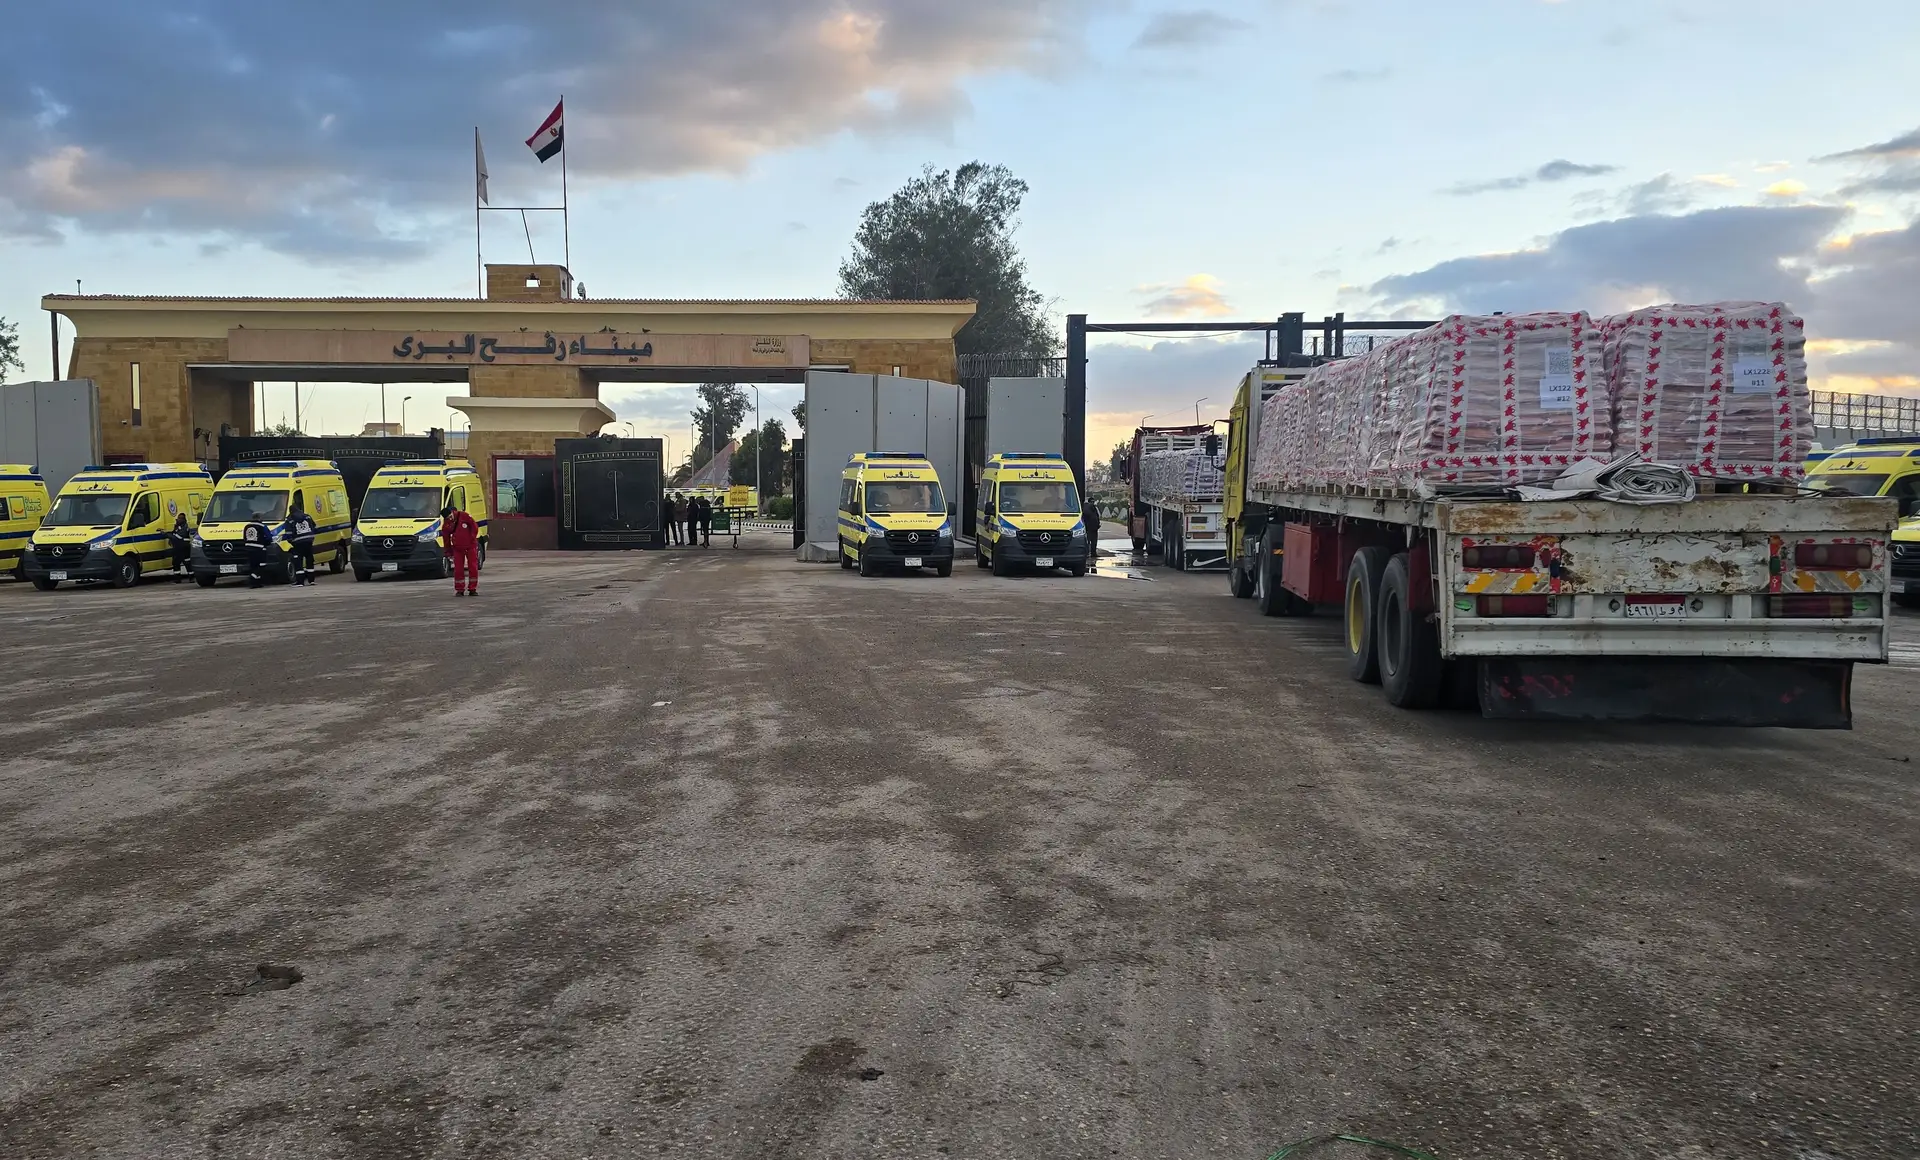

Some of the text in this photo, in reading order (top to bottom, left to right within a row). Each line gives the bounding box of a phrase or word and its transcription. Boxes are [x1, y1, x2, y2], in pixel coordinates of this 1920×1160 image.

[480, 331, 566, 362] رفح
[569, 335, 652, 363] ميناء
[1751, 379, 1766, 387] #11
[1549, 385, 1572, 393] LX122
[1627, 605, 1655, 616] ٤٩٦١
